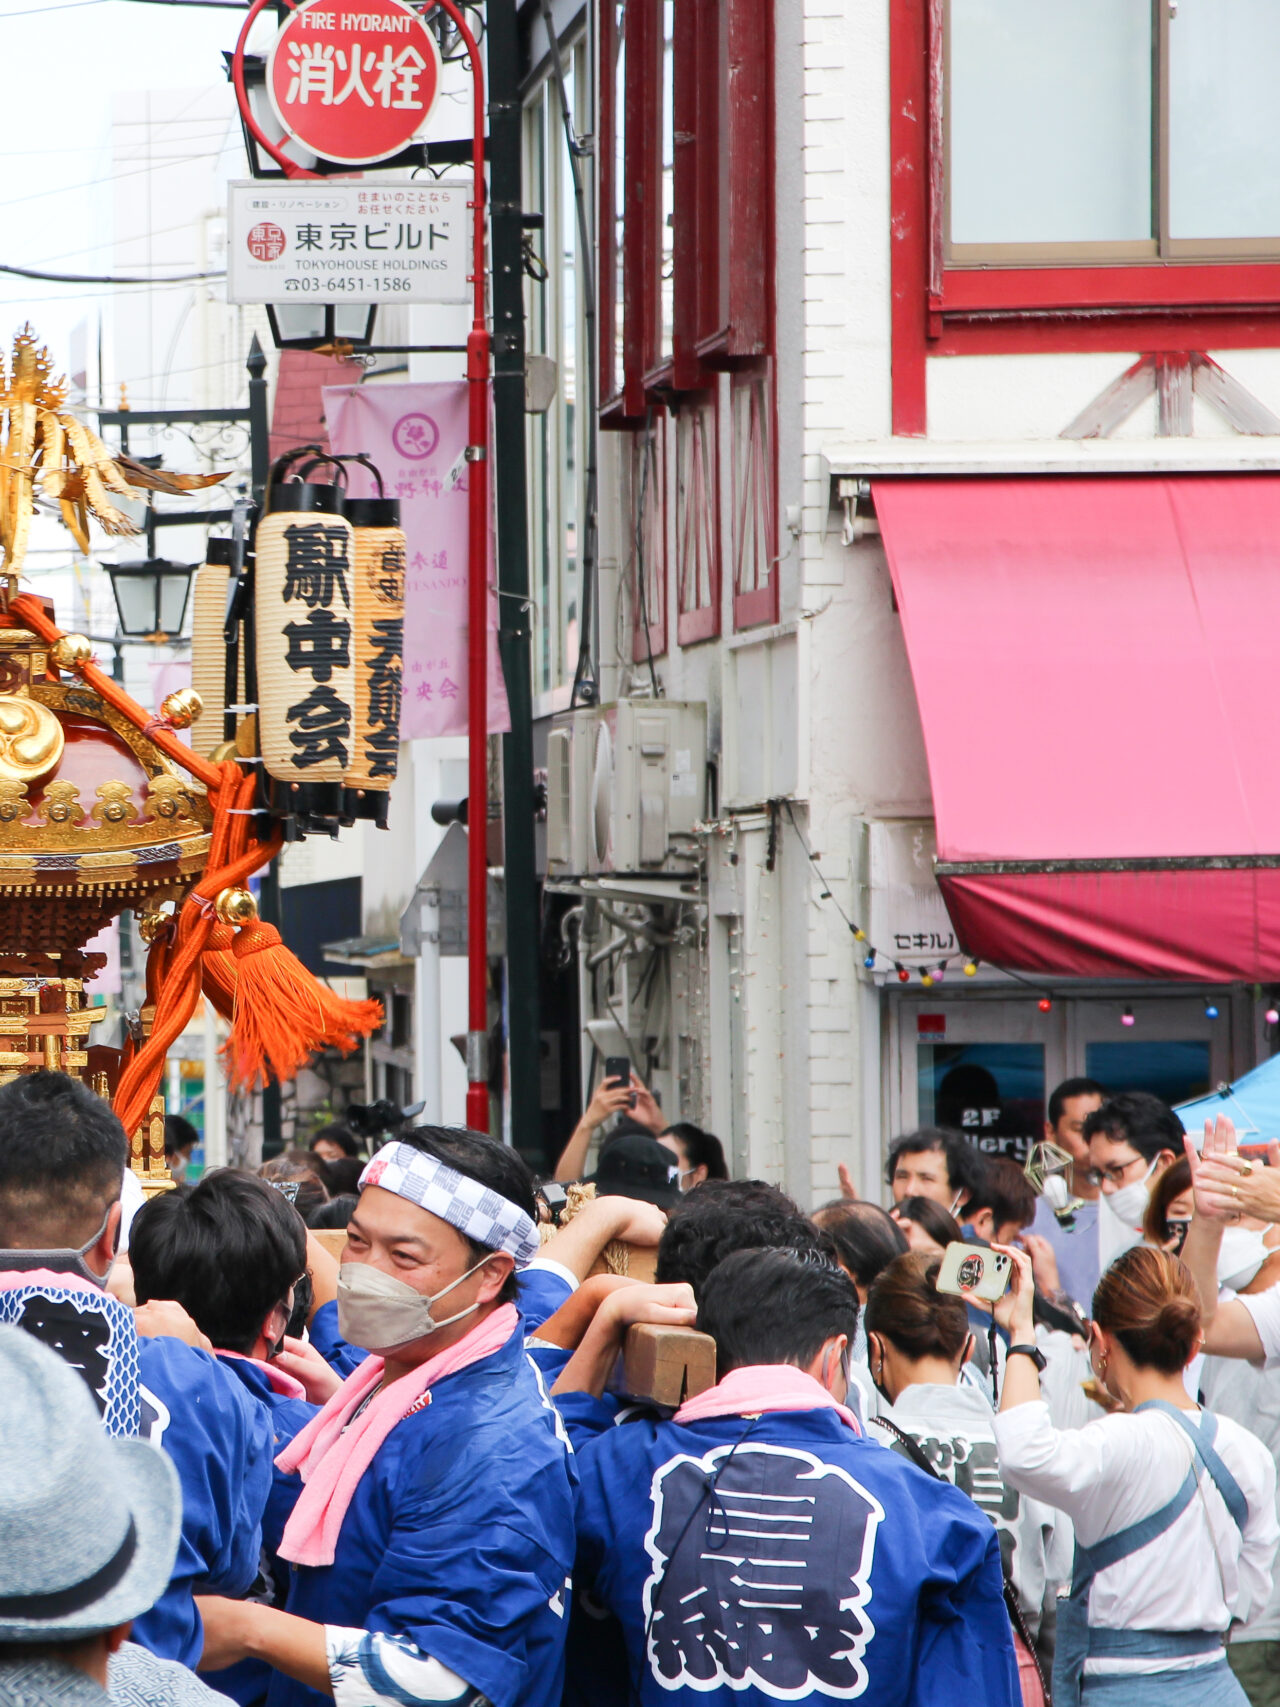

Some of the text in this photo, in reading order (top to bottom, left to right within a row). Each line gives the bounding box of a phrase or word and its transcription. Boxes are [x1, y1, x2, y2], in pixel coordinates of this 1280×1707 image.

[302, 12, 413, 33] FIRE HYDRANT
[286, 41, 426, 109] 消火栓
[358, 192, 451, 202] 住まいのことなら
[358, 205, 440, 215] お任せください
[295, 222, 450, 251] 東京ビルド
[296, 260, 378, 271] TOKYOHOUSE
[383, 260, 448, 271] HOLDINGS
[301, 277, 412, 292] 03-6451-1586
[410, 549, 448, 571] 参道
[411, 657, 451, 674] 由が丘
[961, 1108, 1001, 1128] 2F
[965, 1133, 1034, 1161] llery
